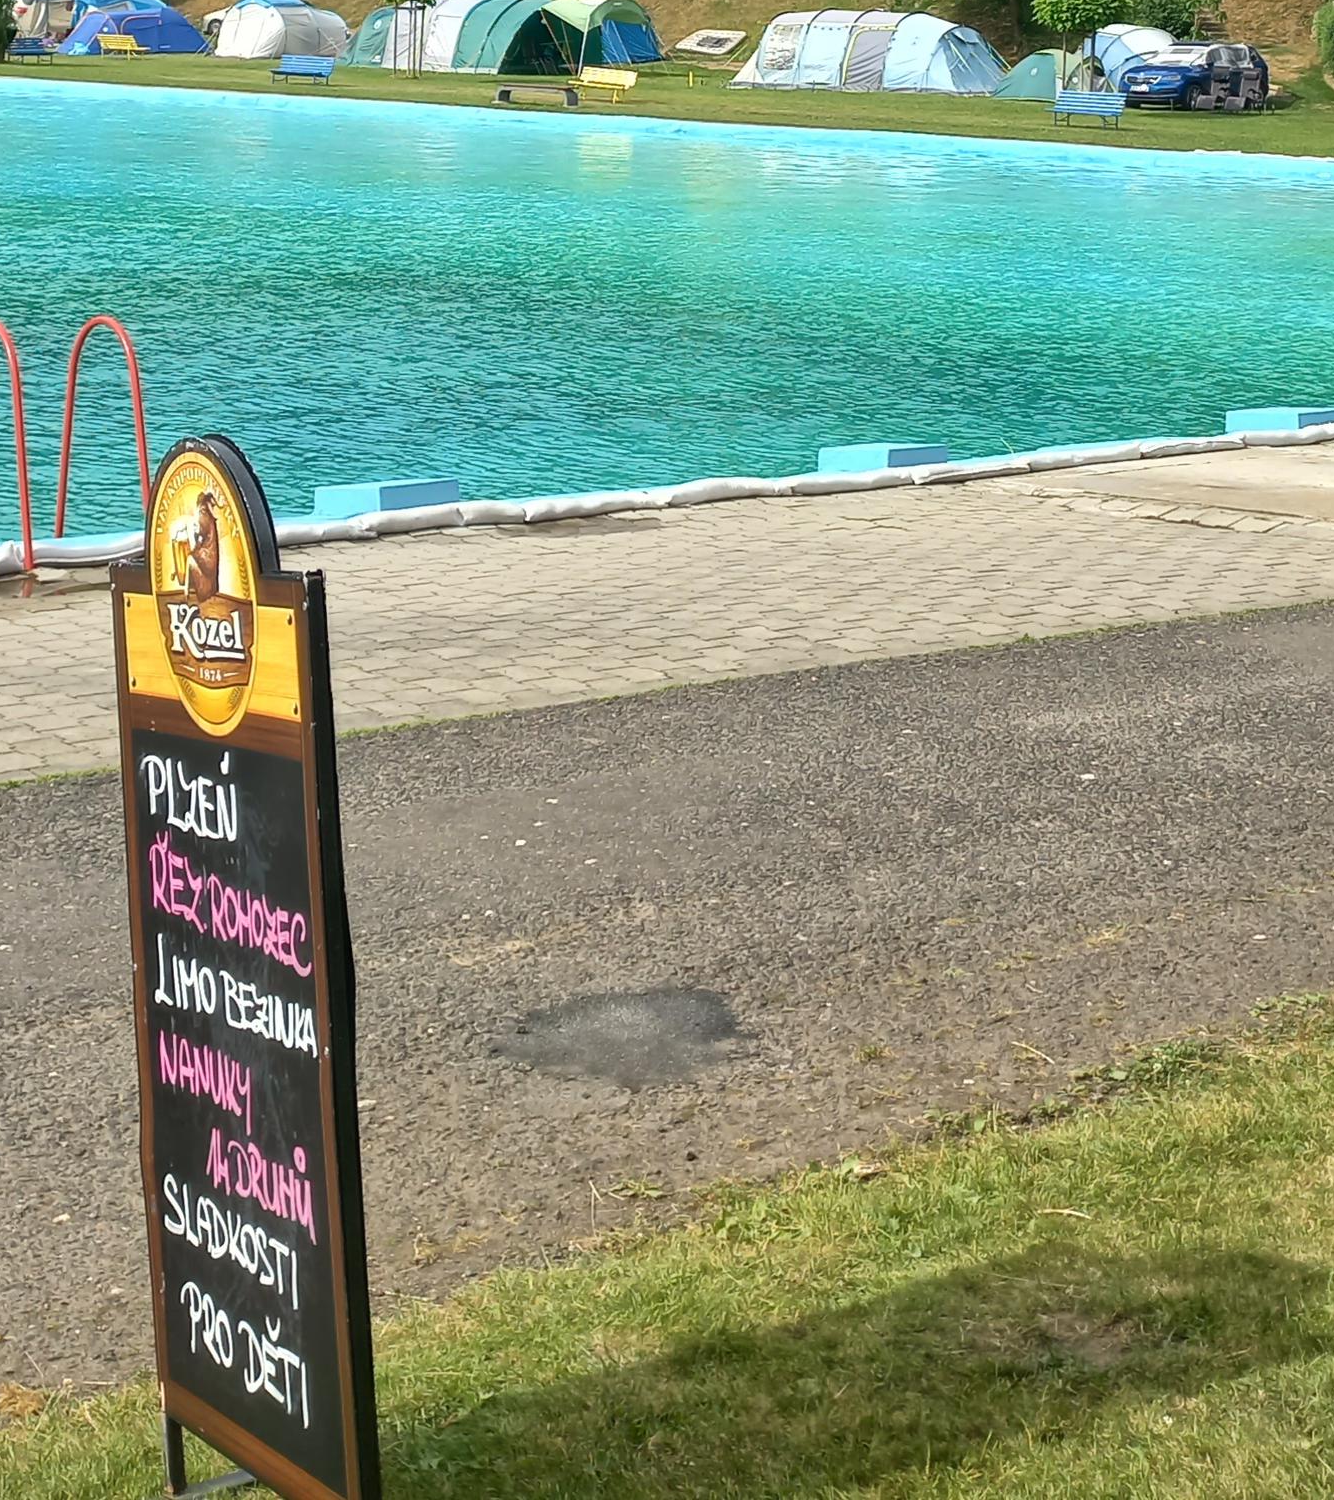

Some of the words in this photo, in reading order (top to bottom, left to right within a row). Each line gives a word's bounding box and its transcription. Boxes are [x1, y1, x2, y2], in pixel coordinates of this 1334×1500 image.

[167, 603, 246, 660] Kozel
[199, 667, 221, 682] 1874
[155, 933, 216, 1014] LIMO
[158, 1028, 252, 1136] NANUKY
[164, 1173, 299, 1310] SLADKOSTI
[180, 1281, 233, 1368] PRO
